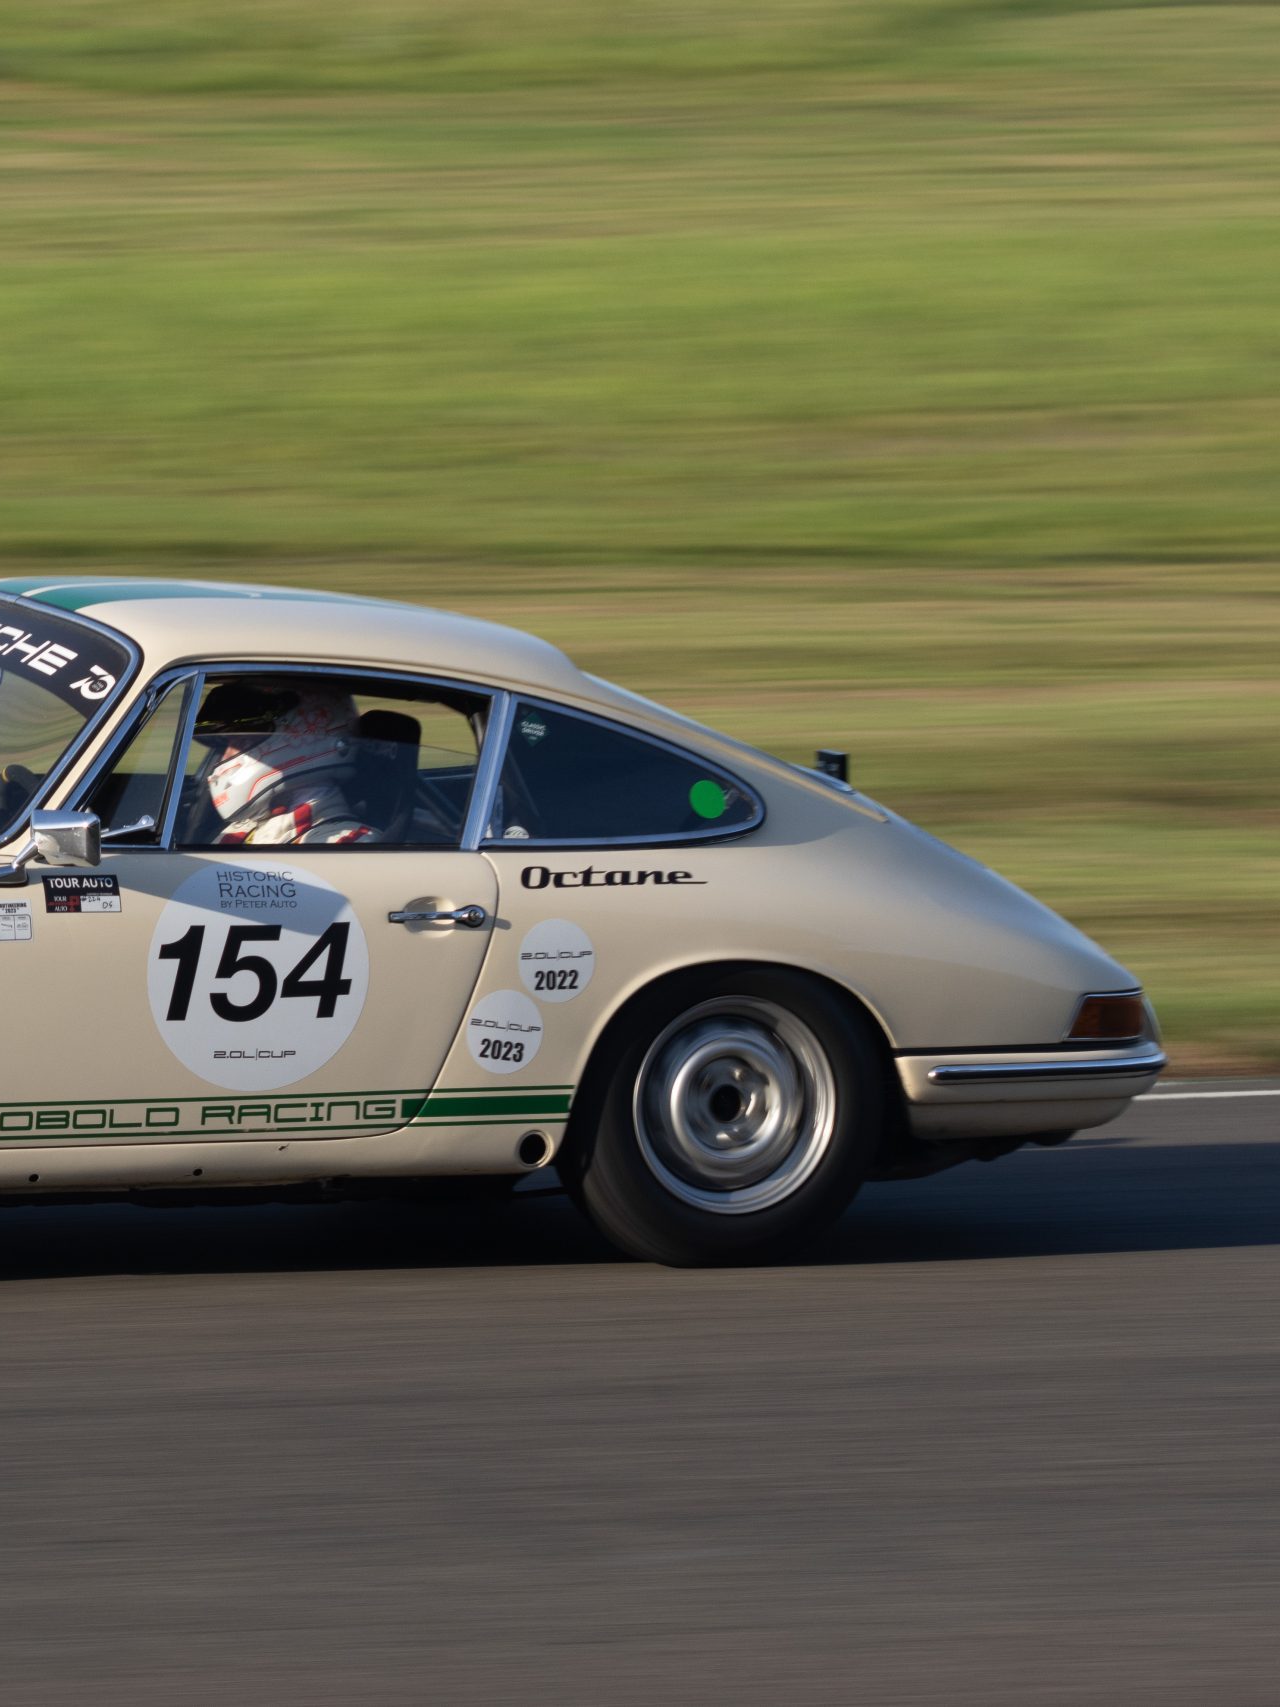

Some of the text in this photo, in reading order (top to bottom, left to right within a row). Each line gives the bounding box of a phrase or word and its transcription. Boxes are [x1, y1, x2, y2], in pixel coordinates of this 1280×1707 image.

[47, 877, 113, 889] TOUR AUTO
[216, 871, 294, 882] HISTORIC
[520, 865, 709, 889] Octane
[218, 883, 297, 899] RACING
[220, 900, 298, 908] BY PETER AUTO
[158, 922, 352, 1023] 154
[534, 970, 579, 990] 2022
[479, 1039, 524, 1062] 2023
[201, 1099, 396, 1126] RACING
